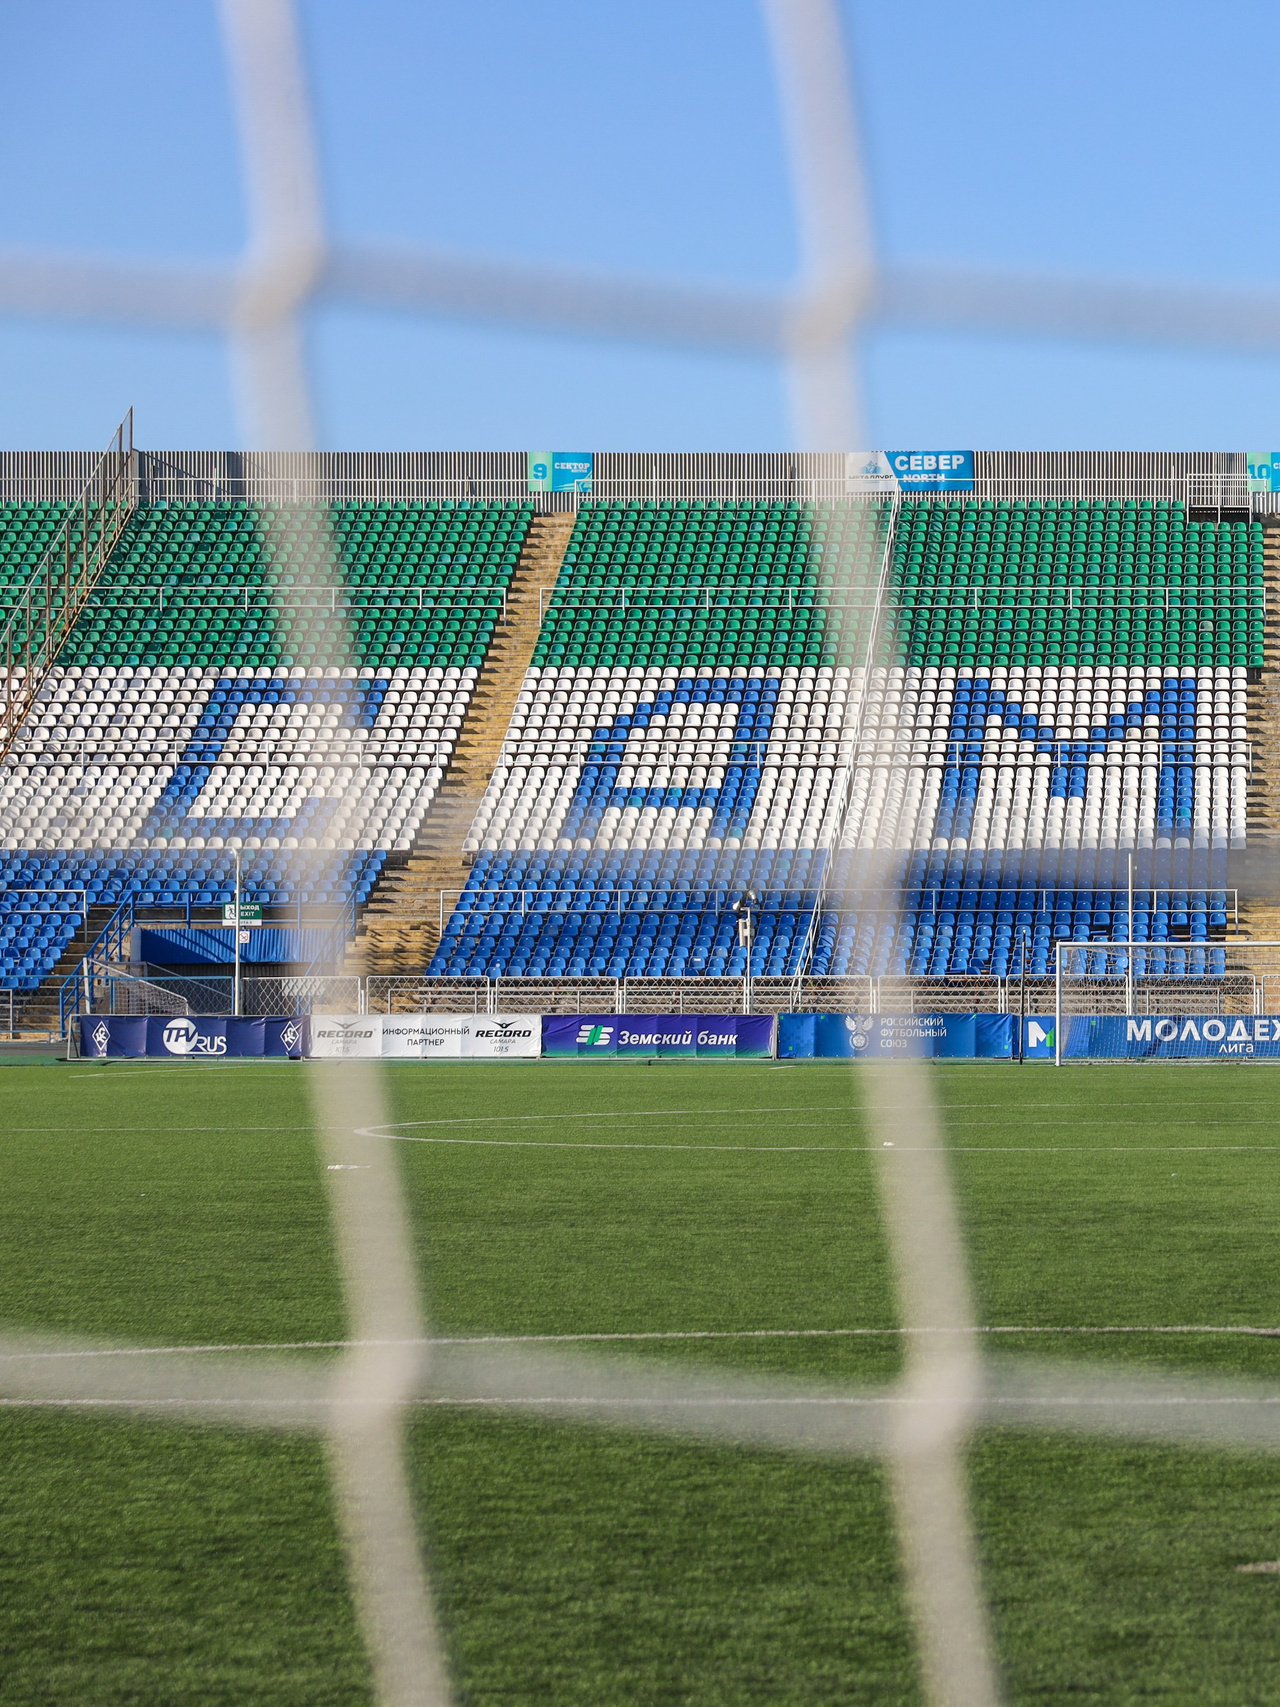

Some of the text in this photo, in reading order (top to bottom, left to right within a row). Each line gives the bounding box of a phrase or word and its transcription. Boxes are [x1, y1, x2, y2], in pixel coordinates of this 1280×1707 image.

[554, 462, 590, 470] СЕКТОР
[894, 454, 965, 471] СЕВЕР
[533, 463, 547, 480] 9
[1247, 463, 1271, 480] 10
[902, 473, 946, 483] NORTH
[880, 1016, 944, 1027] РОССИЙСКИЙ
[317, 1030, 373, 1039] RECORD
[382, 1026, 470, 1037] ИНФОРМАЦИОННЫЙ
[475, 1030, 532, 1038] RECORD
[618, 1029, 738, 1045] Земский банк
[880, 1026, 947, 1038] ФУТБОЛЬНЫЙ
[196, 1035, 227, 1055] RUS
[407, 1038, 445, 1046] ПАРТНЕР
[880, 1039, 907, 1048] СОЮЗ
